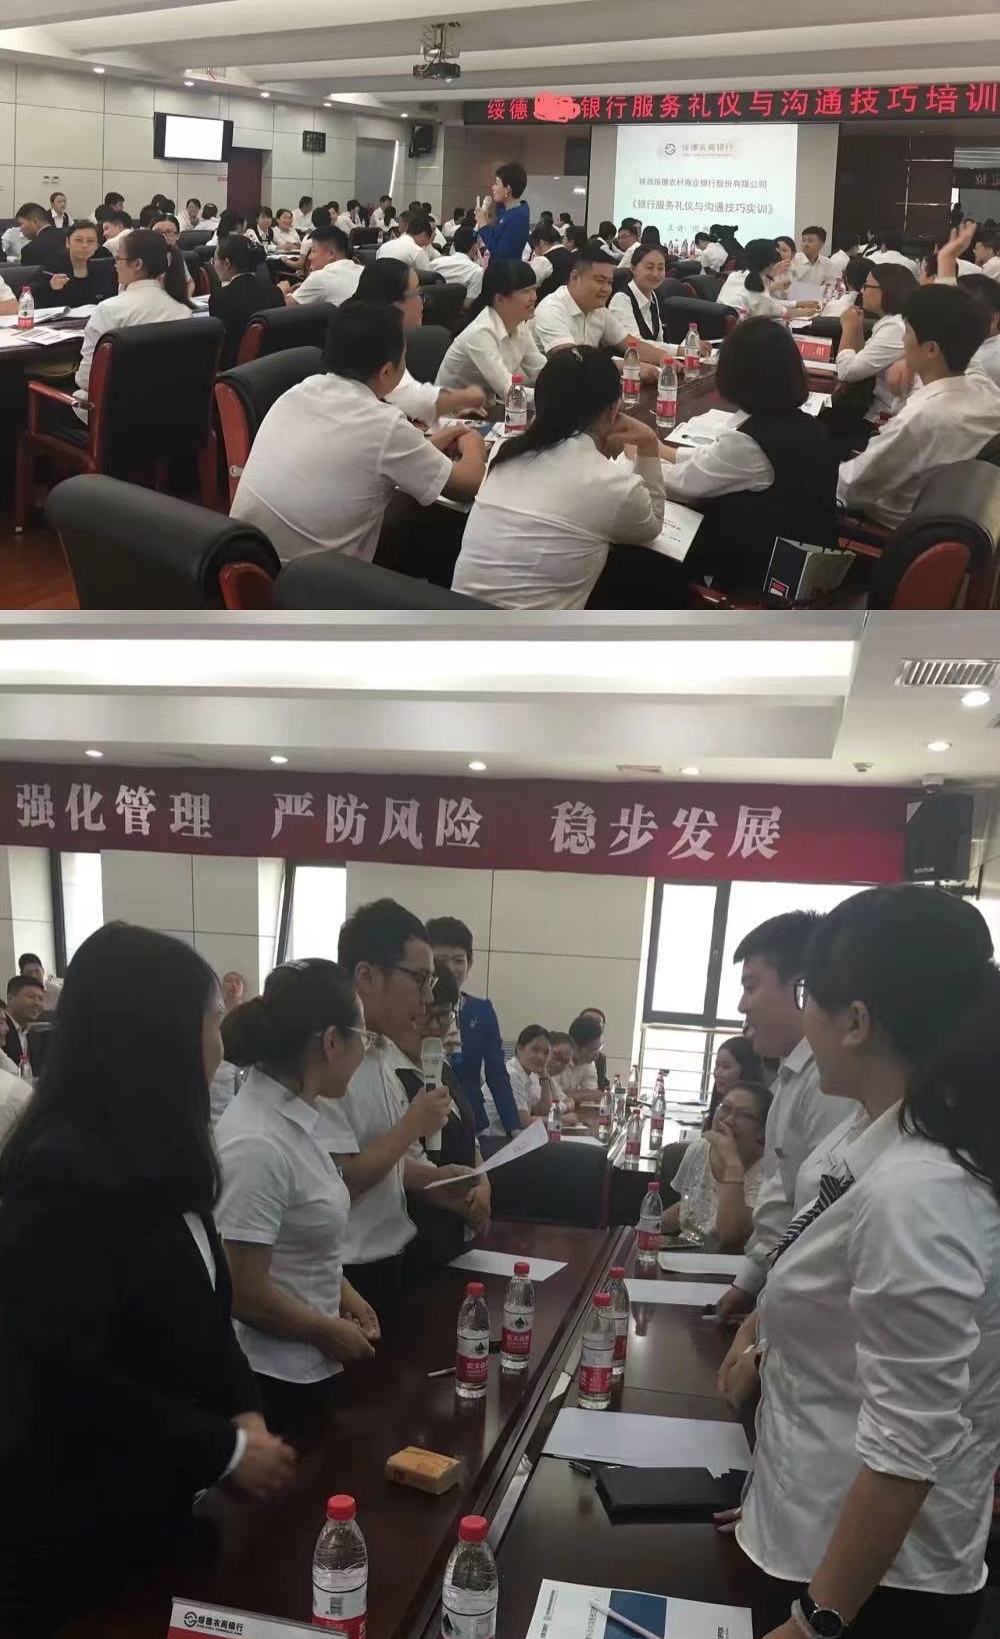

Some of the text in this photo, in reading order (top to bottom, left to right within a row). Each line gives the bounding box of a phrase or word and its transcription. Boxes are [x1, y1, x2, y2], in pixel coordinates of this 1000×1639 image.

[487, 82, 999, 121] 绥德银行服务礼仪与沟通技巧培训
[16, 783, 783, 861] 强化管理 严防风险 稳步发展
